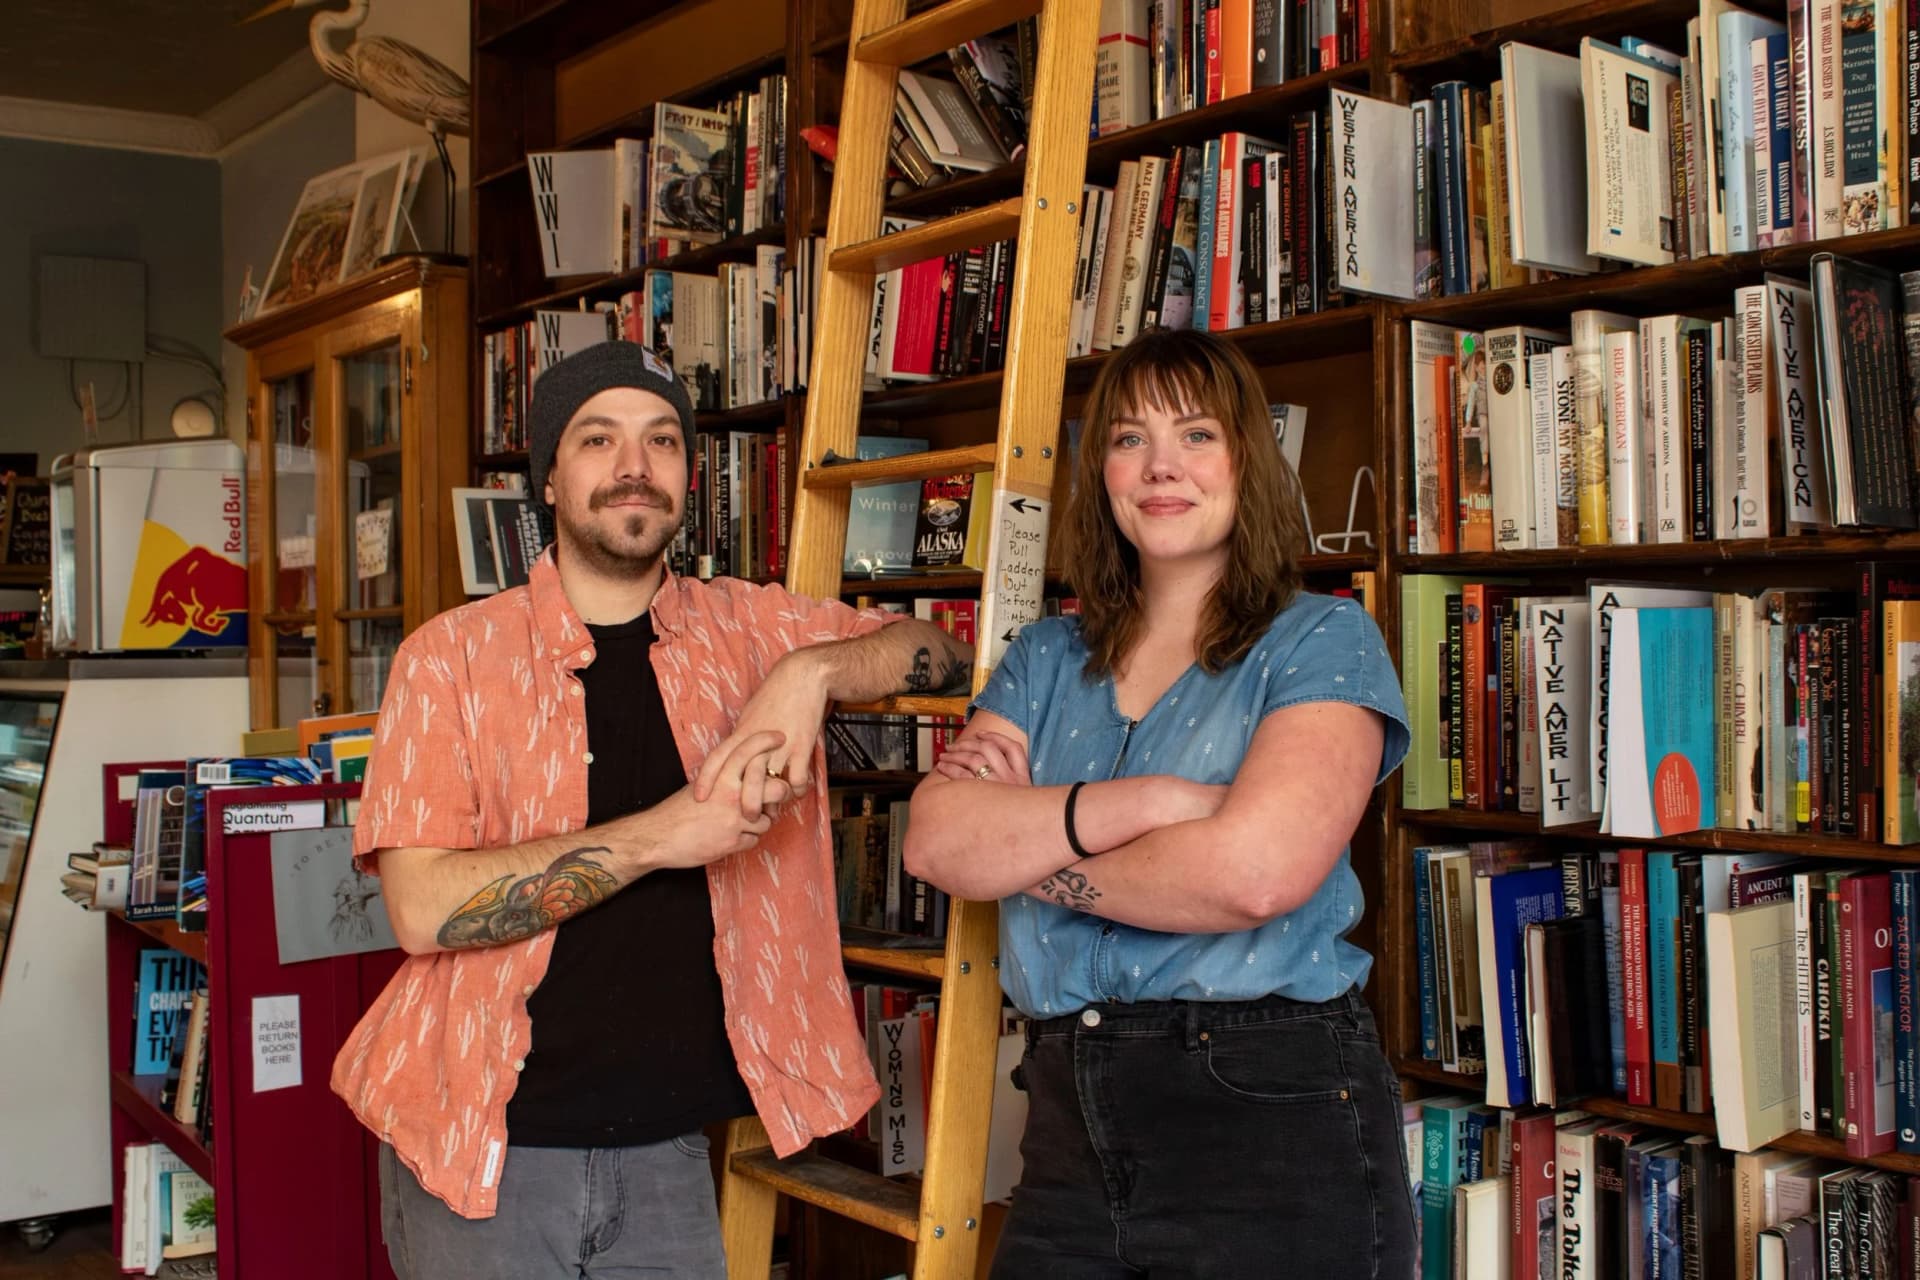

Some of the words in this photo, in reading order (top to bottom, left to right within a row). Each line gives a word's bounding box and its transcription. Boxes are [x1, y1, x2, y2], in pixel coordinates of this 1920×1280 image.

[1821, 3, 1832, 22] THE
[1821, 24, 1832, 53] WORLD
[1909, 31, 1918, 41] at
[1909, 42, 1919, 60] the
[1753, 64, 1766, 96] GOING
[1774, 58, 1788, 88] LAND
[1822, 55, 1833, 89] RUSHED
[1909, 62, 1919, 100] Brown
[1673, 90, 1682, 119] ONCE
[1775, 90, 1790, 130] CIRCLE
[1823, 90, 1833, 100] IN
[1754, 98, 1766, 124] OVER
[1910, 102, 1920, 136] Palace
[1337, 95, 1359, 180] WESTERN
[1416, 111, 1424, 146] MONTANA
[1674, 122, 1684, 152] UPON
[1755, 126, 1767, 152] EAST
[1416, 148, 1424, 166] PLACE
[1143, 162, 1154, 186] NAZI
[1204, 166, 1212, 188] THE
[1416, 168, 1424, 190] NAMES
[1676, 166, 1686, 198] TOWN
[1133, 182, 1141, 204] AND
[1757, 169, 1768, 226] HASSELSTROM
[1778, 160, 1790, 220] HASSELSTROM
[1135, 190, 1150, 240] GERMANY
[1202, 194, 1212, 226] NAZI
[1126, 227, 1135, 256] JEWS
[1344, 184, 1358, 277] AMERICAN
[1096, 243, 1104, 257] SA
[1088, 260, 1102, 306] GENERALS
[1196, 232, 1210, 312] CONSCIENCE
[977, 292, 987, 336] GENOCIDE
[1746, 292, 1762, 308] THE
[1746, 310, 1762, 360] CONTESTED
[1614, 348, 1626, 378] RIDE
[1746, 362, 1762, 394] PLAINS
[1534, 358, 1548, 400] ORDEAL
[1556, 380, 1570, 426] STONE
[1776, 288, 1800, 380] NATIVE
[1788, 388, 1811, 508] AMERICAN
[1614, 380, 1627, 449] AMERICAN
[1662, 416, 1669, 428] OF
[1535, 412, 1550, 456] HUNGER
[1558, 429, 1570, 452] MY
[222, 477, 241, 513] Bull
[1559, 454, 1571, 506] MOUNT
[859, 498, 917, 513] Winter
[223, 516, 241, 552] Red
[518, 504, 536, 567] BARBARO
[917, 531, 964, 553] ALASKA
[1003, 519, 1041, 542] Please
[1009, 540, 1028, 558] Pull
[1000, 560, 1041, 577] Ladder
[1466, 632, 1474, 648] THE
[1503, 615, 1513, 638] THE
[1451, 625, 1461, 664] LIKE
[1540, 608, 1565, 694] NATIVE
[1722, 635, 1731, 676] BEING
[1451, 668, 1461, 676] A
[1466, 650, 1476, 688] SEVEN
[1503, 640, 1513, 685] DENVER
[1503, 686, 1513, 714] MINT
[1723, 680, 1732, 720] THERE
[1810, 678, 1818, 719] COLUMBUS
[1451, 680, 1461, 754] HURRICA
[1467, 690, 1476, 742] DAUGHTERS
[1544, 702, 1568, 760] AMER
[1468, 744, 1475, 755] OF
[1452, 764, 1460, 790] USED
[1468, 760, 1476, 782] EVE
[1550, 768, 1570, 810] LIT
[223, 812, 293, 826] Quantum
[1562, 858, 1579, 893] LORDS
[1747, 876, 1782, 894] ANCIENT
[134, 904, 152, 914] Sarah
[1418, 887, 1428, 912] Light
[1563, 897, 1580, 910] OF
[1633, 904, 1641, 918] THE
[1624, 912, 1632, 928] THE
[1634, 920, 1642, 944] URALS
[1657, 918, 1665, 942] THE
[1683, 922, 1693, 942] THE
[1624, 930, 1632, 960] BRONZE
[1634, 946, 1642, 962] AND
[1797, 928, 1808, 952] The
[1844, 929, 1854, 958] PEOPLE
[1896, 916, 1910, 968] SACRED
[1423, 952, 1432, 988] Ancient
[1634, 964, 1642, 999] WESTERN
[1658, 942, 1668, 1005] ARCHAEOLOGY
[1684, 948, 1694, 992] CHINESE
[1844, 960, 1854, 974] OF
[1626, 978, 1634, 998] IRON
[1798, 956, 1811, 1016] HITTITES
[1844, 975, 1854, 990] THE
[1424, 995, 1432, 1014] Past
[1626, 998, 1634, 1017] AGES
[1660, 1006, 1668, 1016] OF
[1817, 958, 1832, 1040] CAHOKIA
[1846, 992, 1854, 1020] ANDES
[1898, 974, 1912, 1032] ANGKOR
[259, 1020, 297, 1032] PLEASE
[1636, 1000, 1644, 1029] SIBERIA
[1686, 997, 1696, 1054] NEOLITHIC
[258, 1032, 298, 1043] RETURN
[1660, 1018, 1668, 1050] CHINA
[262, 1044, 296, 1055] BOOKS
[265, 1054, 292, 1065] HERE
[884, 1022, 905, 1108] WYOMING
[888, 1114, 906, 1164] MISC
[1563, 1168, 1581, 1218] The
[1742, 1172, 1750, 1214] ANCIENT
[1829, 1209, 1842, 1235] The
[1860, 1210, 1871, 1236] The
[1563, 1224, 1581, 1280] Tolte
[1652, 1248, 1660, 1278] CENTRAL
[1830, 1238, 1843, 1274] Great
[1860, 1238, 1872, 1274] Great
